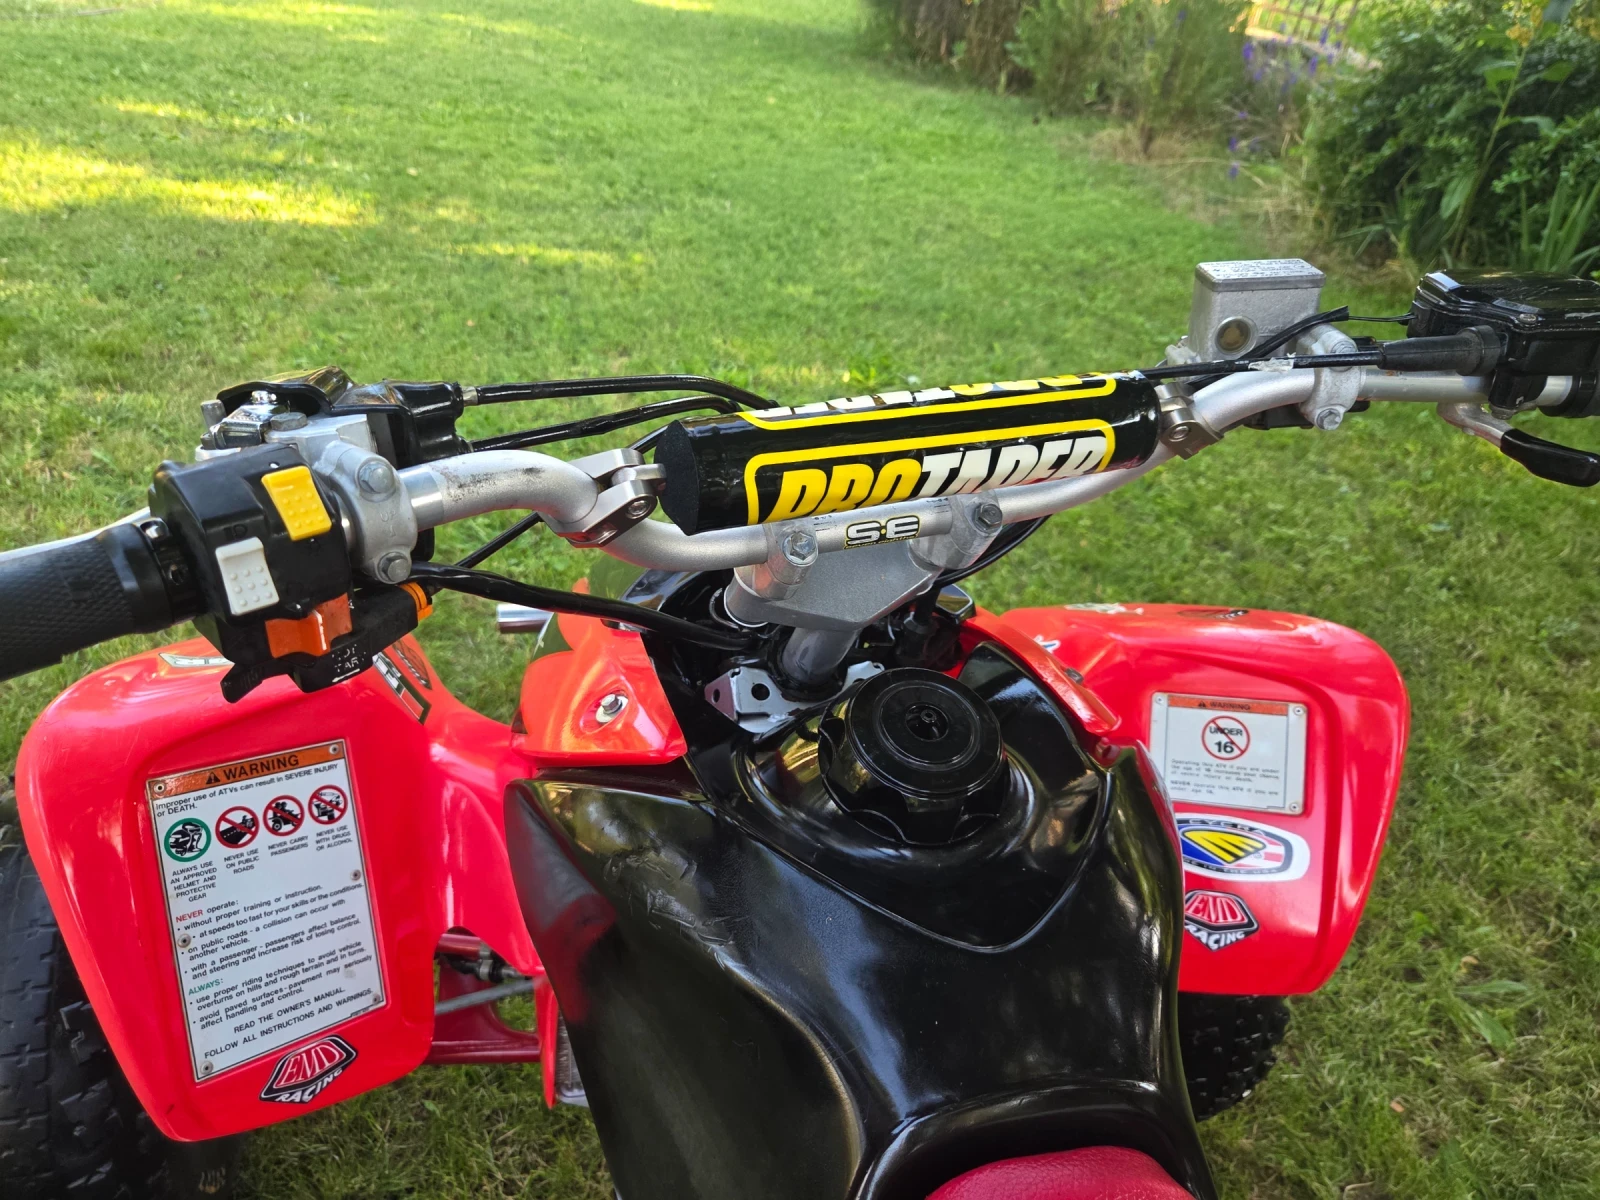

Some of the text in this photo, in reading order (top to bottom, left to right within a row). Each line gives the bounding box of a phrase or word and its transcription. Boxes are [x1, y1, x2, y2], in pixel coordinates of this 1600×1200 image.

[1209, 701, 1251, 711] WARNING
[1209, 726, 1243, 736] UNDER
[1214, 740, 1235, 754] 16
[223, 754, 299, 781] WARNING
[193, 794, 207, 802] use
[209, 790, 217, 798] of
[218, 786, 238, 796] ATVs
[240, 783, 254, 791] can
[255, 777, 275, 787] result
[284, 768, 313, 781] SEVERE
[314, 763, 338, 774] INJURY
[167, 803, 198, 815] DEATH.
[315, 830, 351, 845] WITH DRUGS
[316, 824, 348, 837] NEVER USE
[267, 835, 309, 850] NEVER CARRY
[270, 842, 309, 857] PASSENGERS
[315, 838, 353, 852] OR ALCOHOL
[223, 848, 259, 862] NEVER USE
[238, 855, 260, 866] PUBLIC
[170, 867, 217, 885] AN APPROVED
[172, 860, 213, 876] ALWAYS USE
[233, 864, 255, 874] ROADS
[174, 875, 217, 891] HELMET AND
[176, 882, 216, 898] PROTECTIVE
[184, 917, 213, 931] without
[215, 909, 240, 923] proper
[243, 899, 271, 912] training
[284, 885, 323, 900] instruction.
[188, 892, 207, 902] GEAR
[1185, 894, 1247, 923] EMD
[175, 900, 239, 923] NEVER operate:
[208, 922, 235, 935] speeds
[235, 918, 248, 926] too
[248, 913, 263, 922] fast
[263, 909, 274, 917] for
[274, 905, 290, 915] your
[291, 899, 309, 909] skills
[317, 893, 328, 901] the
[329, 883, 364, 897] conditions.
[187, 946, 198, 954] on
[200, 938, 224, 951] public
[226, 930, 248, 941] roads
[262, 916, 292, 930] collision
[294, 911, 308, 919] can
[309, 904, 329, 914] occur
[331, 898, 346, 908] with
[1184, 924, 1246, 951] RACING
[189, 937, 250, 961] another vehicle.
[190, 962, 207, 973] with
[219, 945, 258, 964] passenger
[264, 930, 305, 948] passengers
[308, 922, 327, 933] affect
[329, 914, 356, 926] balance
[192, 970, 207, 980] and
[209, 959, 240, 974] steering
[242, 953, 256, 963] and
[258, 943, 289, 957] increase
[291, 938, 304, 946] risk
[315, 927, 335, 938] losing
[336, 918, 361, 931] control.
[196, 994, 211, 1004] use
[213, 984, 239, 999] proper
[242, 976, 263, 987] riding
[265, 961, 305, 979] techniques
[318, 949, 336, 960] avoid
[338, 941, 361, 952] vehicle
[197, 994, 234, 1011] overturns
[247, 983, 262, 993] hills
[264, 978, 278, 987] and
[279, 970, 300, 982] rough
[301, 961, 324, 974] terrain
[326, 956, 339, 965] and
[347, 947, 366, 957] turns.
[188, 978, 224, 996] ALWAYS:
[199, 1010, 220, 1022] avoid
[224, 1000, 247, 1014] paved
[325, 967, 340, 976] may
[343, 954, 372, 969] seriously
[200, 987, 304, 1030] affect handling and control.
[233, 986, 346, 1034] READ THE OWNER'S MANUAL.
[204, 1040, 239, 1059] FOLLOW
[242, 1033, 257, 1044] ALL
[259, 1010, 315, 1037] INSTRUCTIONS
[317, 1003, 333, 1015] AND
[335, 987, 373, 1007] WARNINGS.
[277, 1044, 340, 1087] EMD
[275, 1068, 343, 1103] RACING
